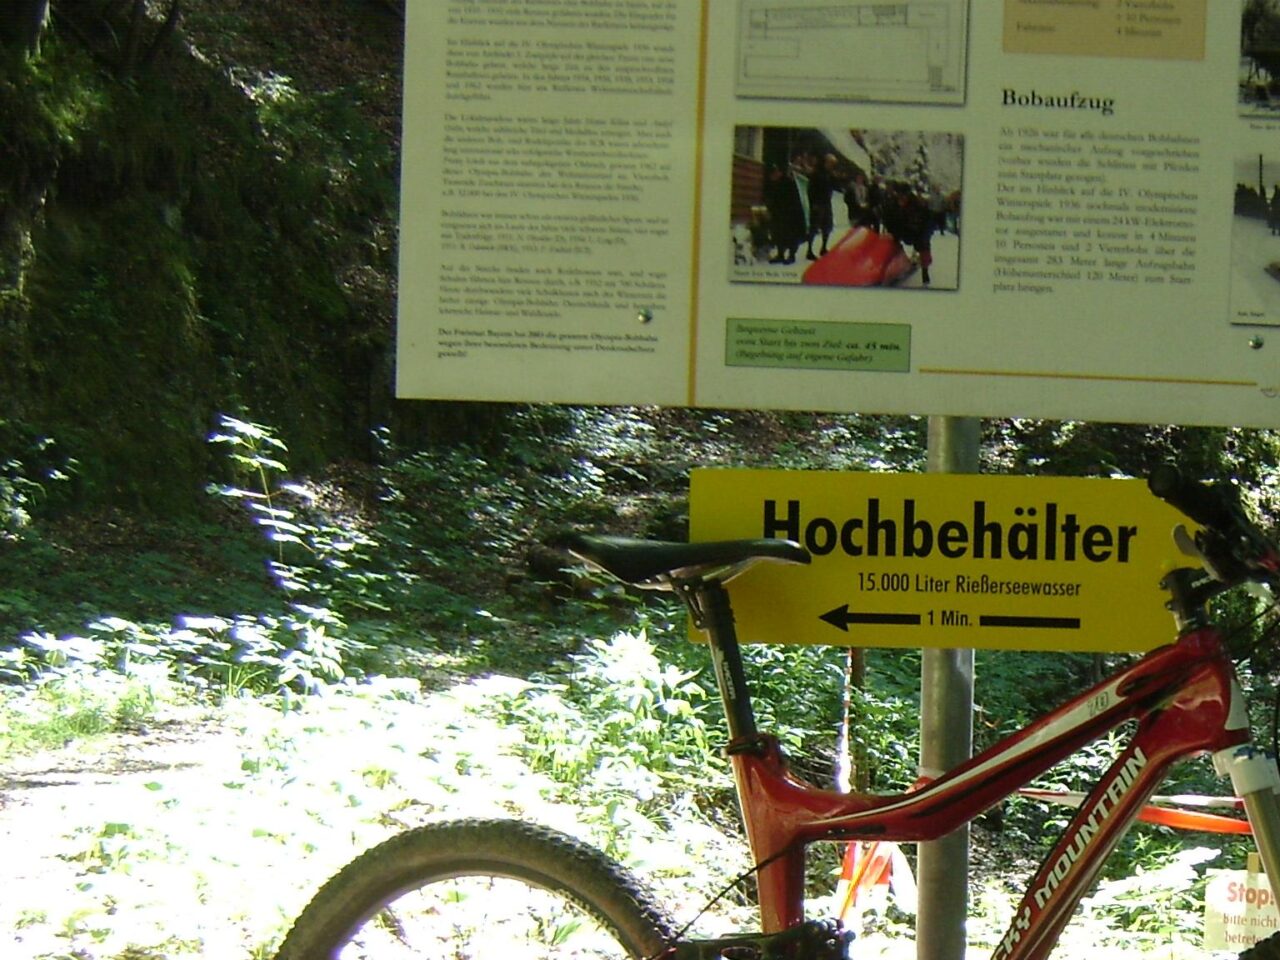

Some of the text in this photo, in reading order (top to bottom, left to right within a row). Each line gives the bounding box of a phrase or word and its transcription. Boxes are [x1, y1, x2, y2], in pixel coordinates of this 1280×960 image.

[1002, 88, 1114, 115] Bobaufzug
[764, 498, 1138, 563] Hochbehälter
[857, 572, 1081, 597] 15.000 Liter Rießerseewasser
[927, 609, 973, 627] 1 Min.
[1034, 746, 1148, 910] MOUNTAIN
[1223, 913, 1277, 928] bitte nicht
